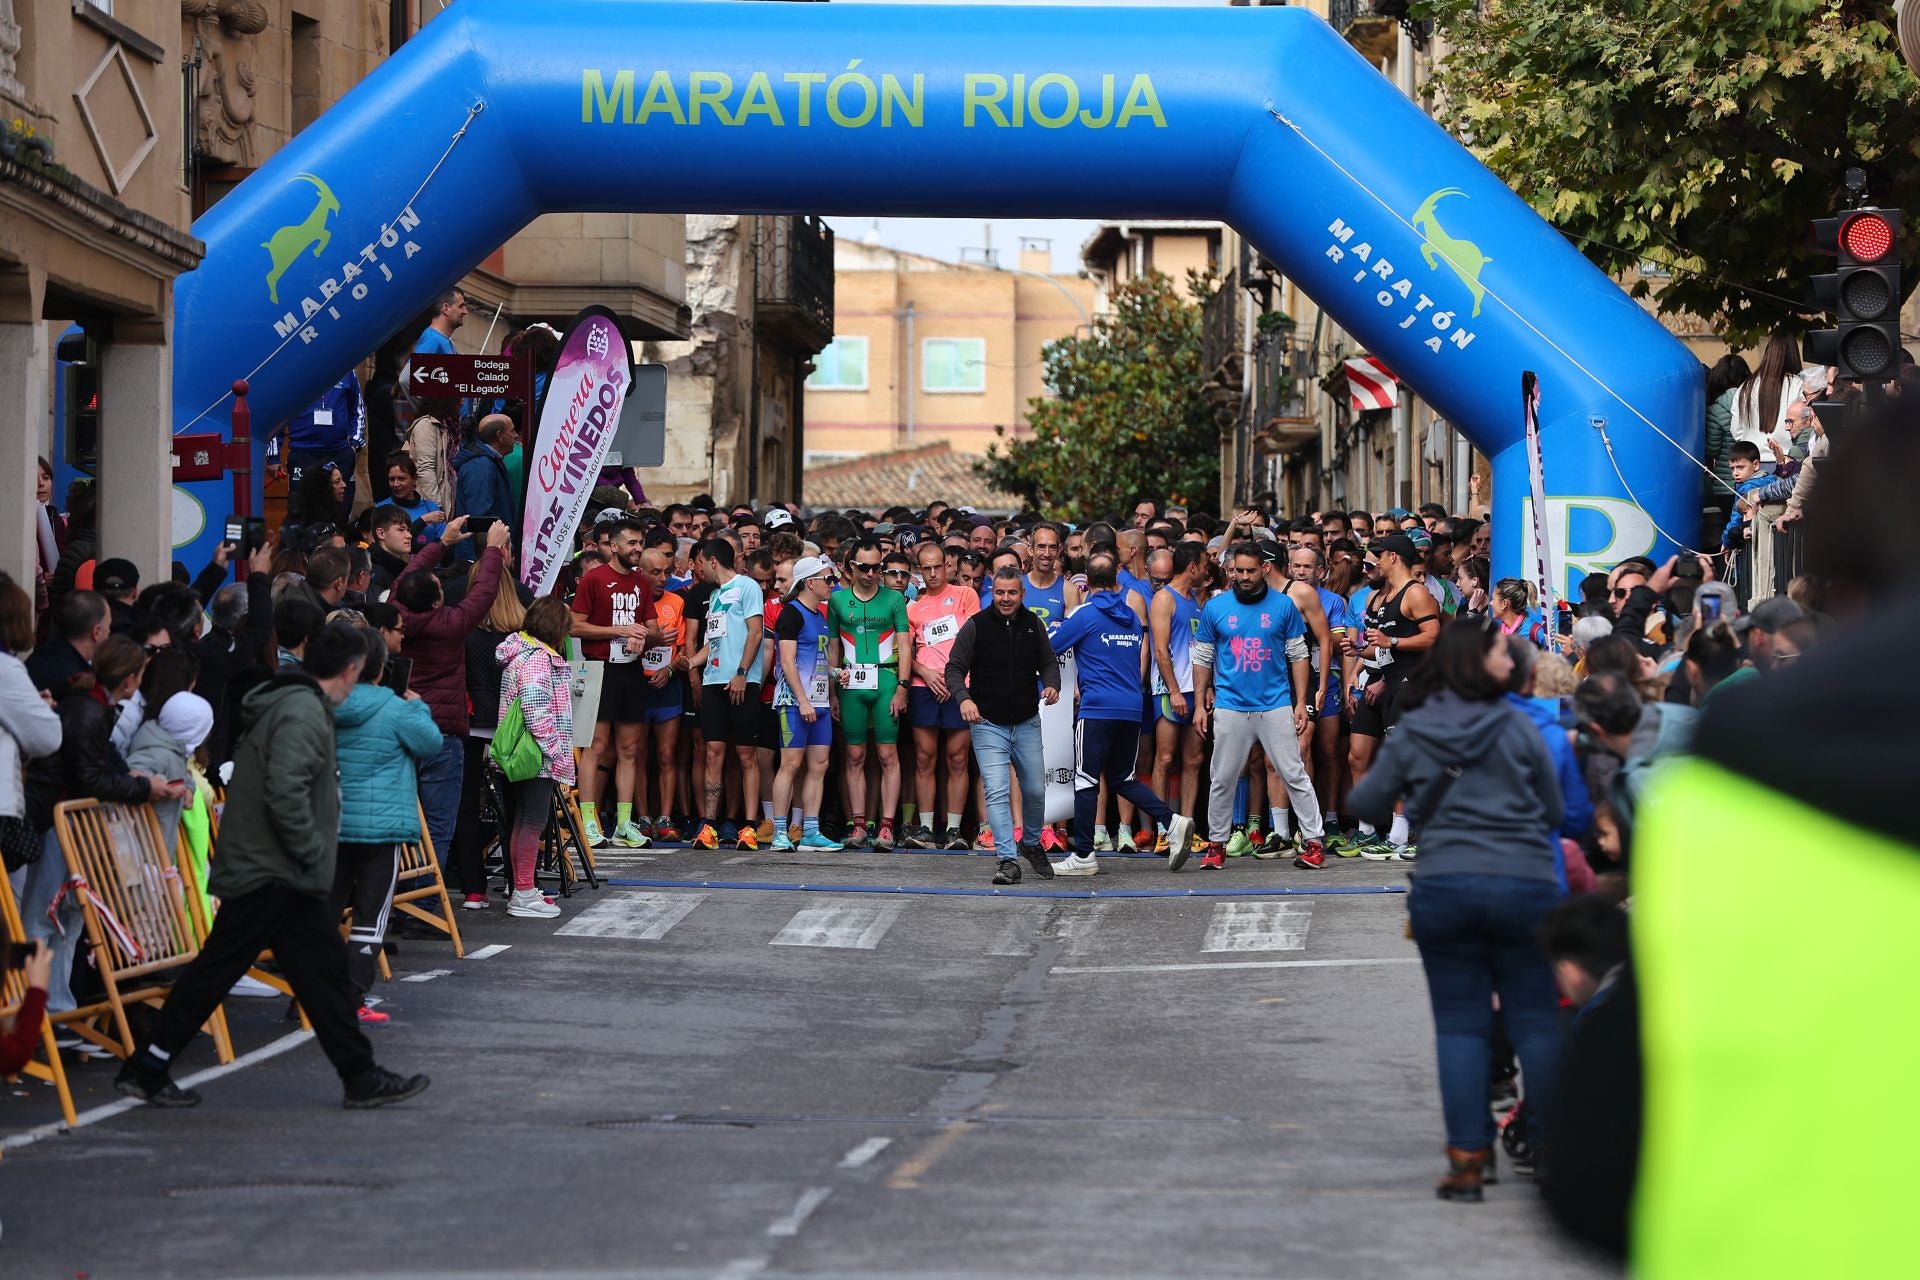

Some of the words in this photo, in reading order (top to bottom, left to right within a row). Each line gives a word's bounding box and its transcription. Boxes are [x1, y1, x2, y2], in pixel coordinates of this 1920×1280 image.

[581, 59, 924, 128] MARATÓN
[963, 73, 1168, 128] RIOJA
[273, 206, 421, 338] MARATÓN
[299, 240, 422, 344] RIOJA
[1325, 244, 1442, 354] RIOJA
[1327, 218, 1476, 350] MARATÓN
[474, 360, 510, 370] Bodega
[477, 372, 509, 381] Calado
[538, 372, 594, 493] Carrera
[559, 364, 624, 495] VIÑEDOS
[555, 521, 571, 548] JOSE
[568, 478, 590, 523] ANTONIO
[589, 437, 607, 478] AGUADO
[1521, 496, 1657, 607] R
[611, 592, 636, 610] 1010
[613, 609, 635, 626] KMS
[931, 623, 949, 636] 485
[645, 652, 663, 663] 483
[816, 682, 826, 693] 252
[854, 671, 866, 681] 40
